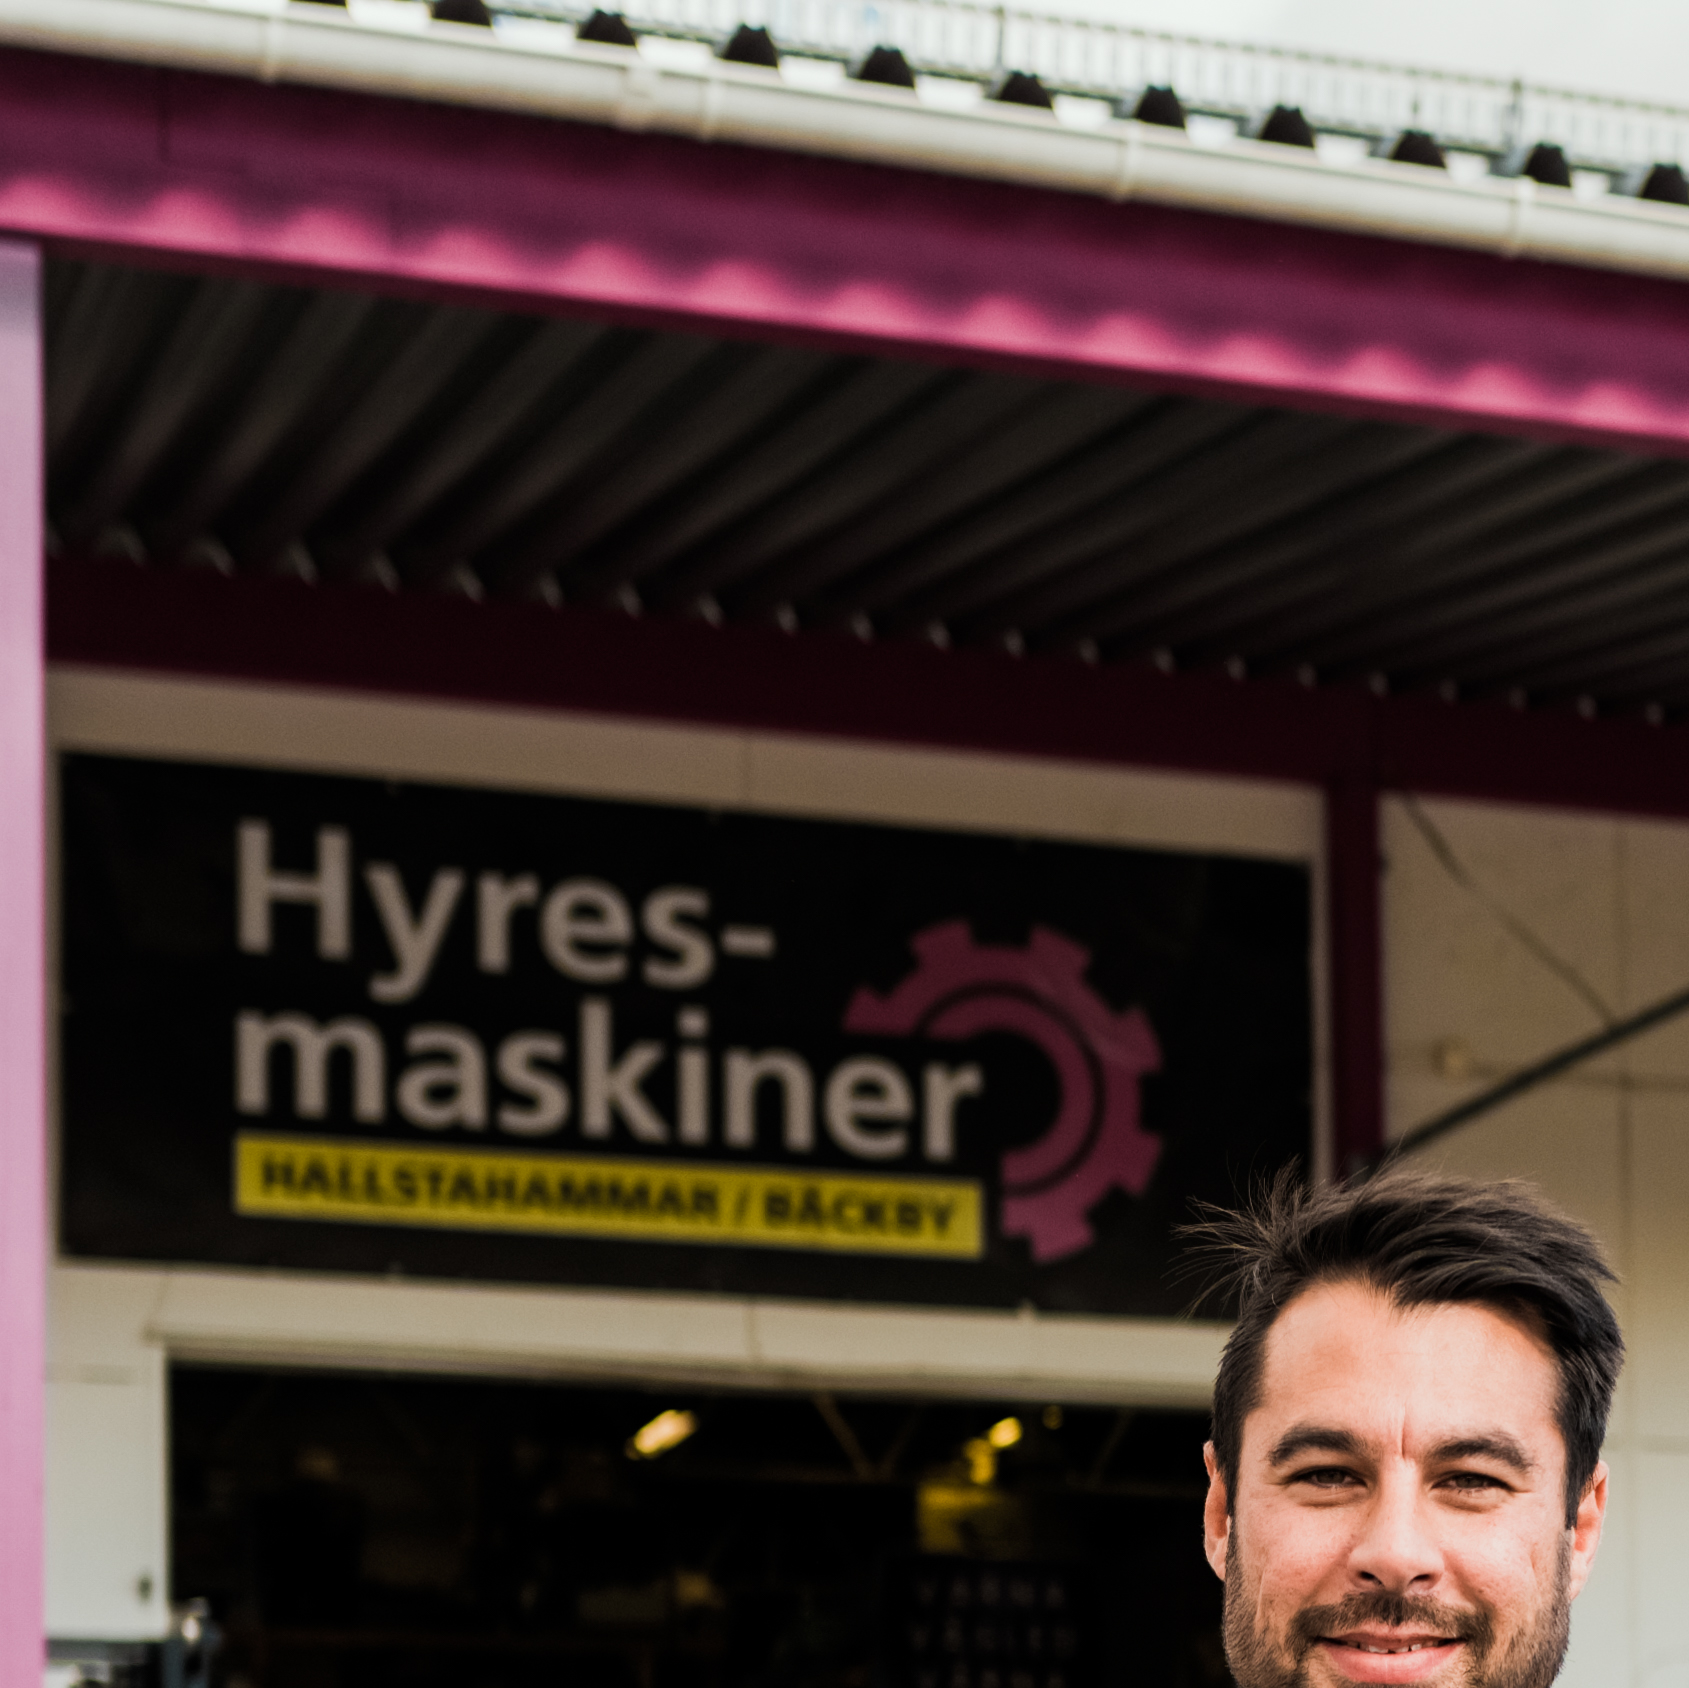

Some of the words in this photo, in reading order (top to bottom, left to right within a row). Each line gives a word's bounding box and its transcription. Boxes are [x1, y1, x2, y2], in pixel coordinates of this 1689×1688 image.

[237, 819, 775, 1001] Hyres-
[235, 998, 983, 1160] maskiner
[261, 1153, 719, 1216] HALLSTAHAMMAR
